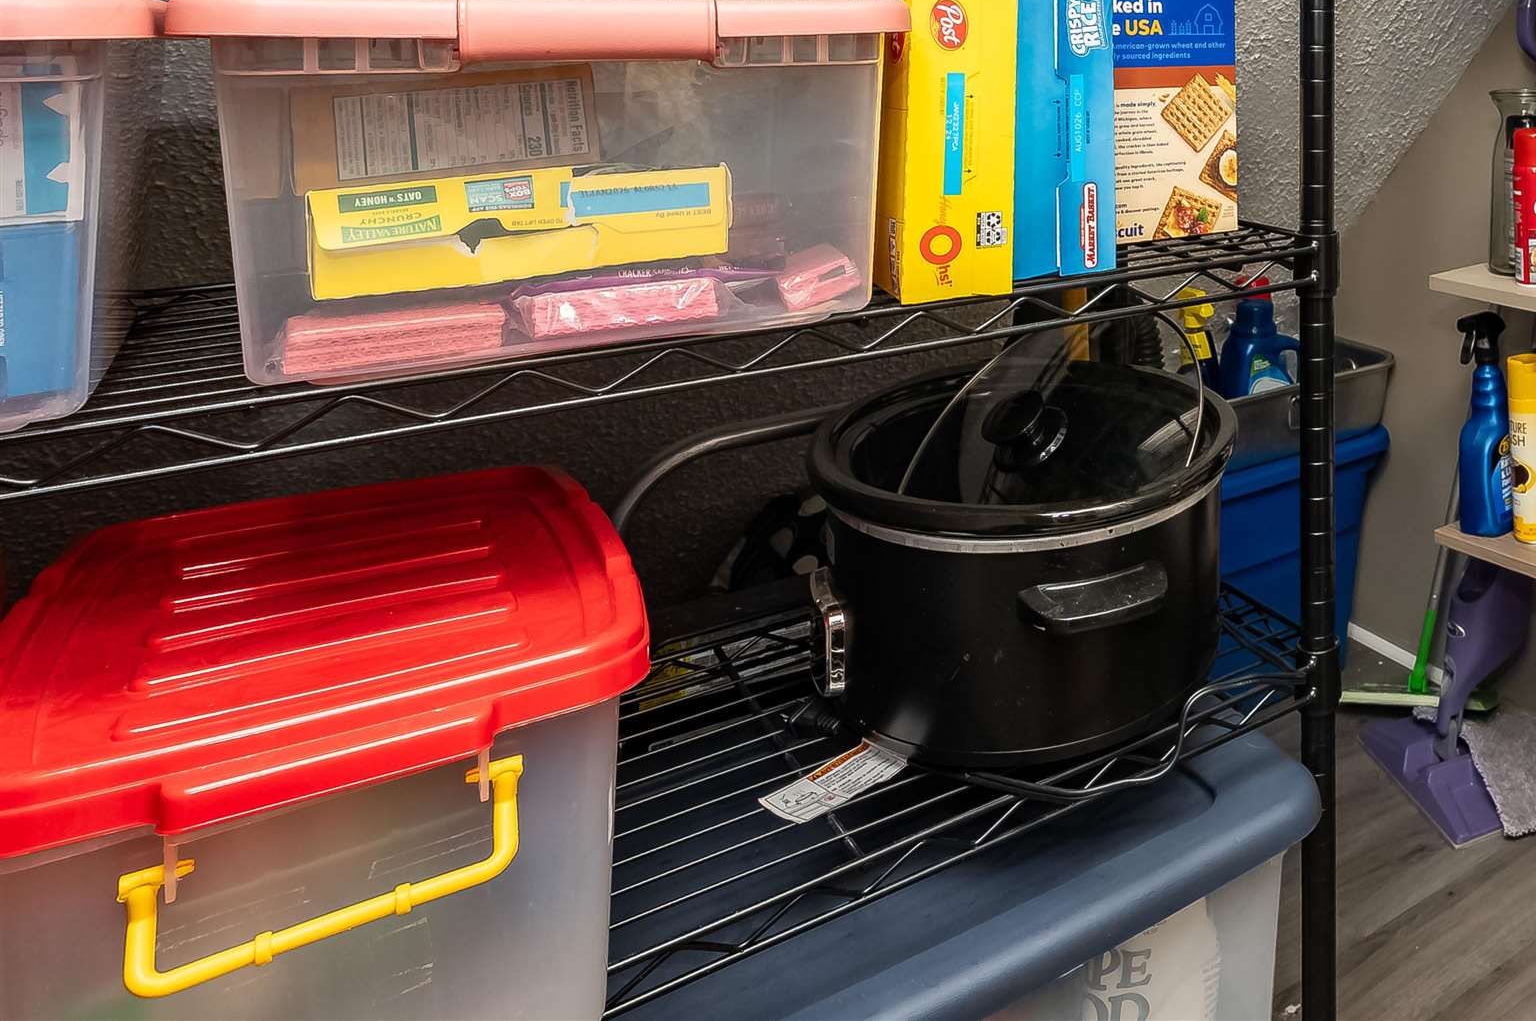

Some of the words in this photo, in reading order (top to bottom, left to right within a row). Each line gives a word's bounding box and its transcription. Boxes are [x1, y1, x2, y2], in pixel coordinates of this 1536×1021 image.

[935, 4, 965, 46] Post
[1125, 19, 1163, 36] USA
[1122, 52, 1151, 60] sourced
[1151, 52, 1191, 60] ingredients
[527, 136, 543, 157] 230
[354, 195, 387, 207] HONEY
[397, 191, 422, 202] OATS
[360, 212, 422, 226] CRUNCHY
